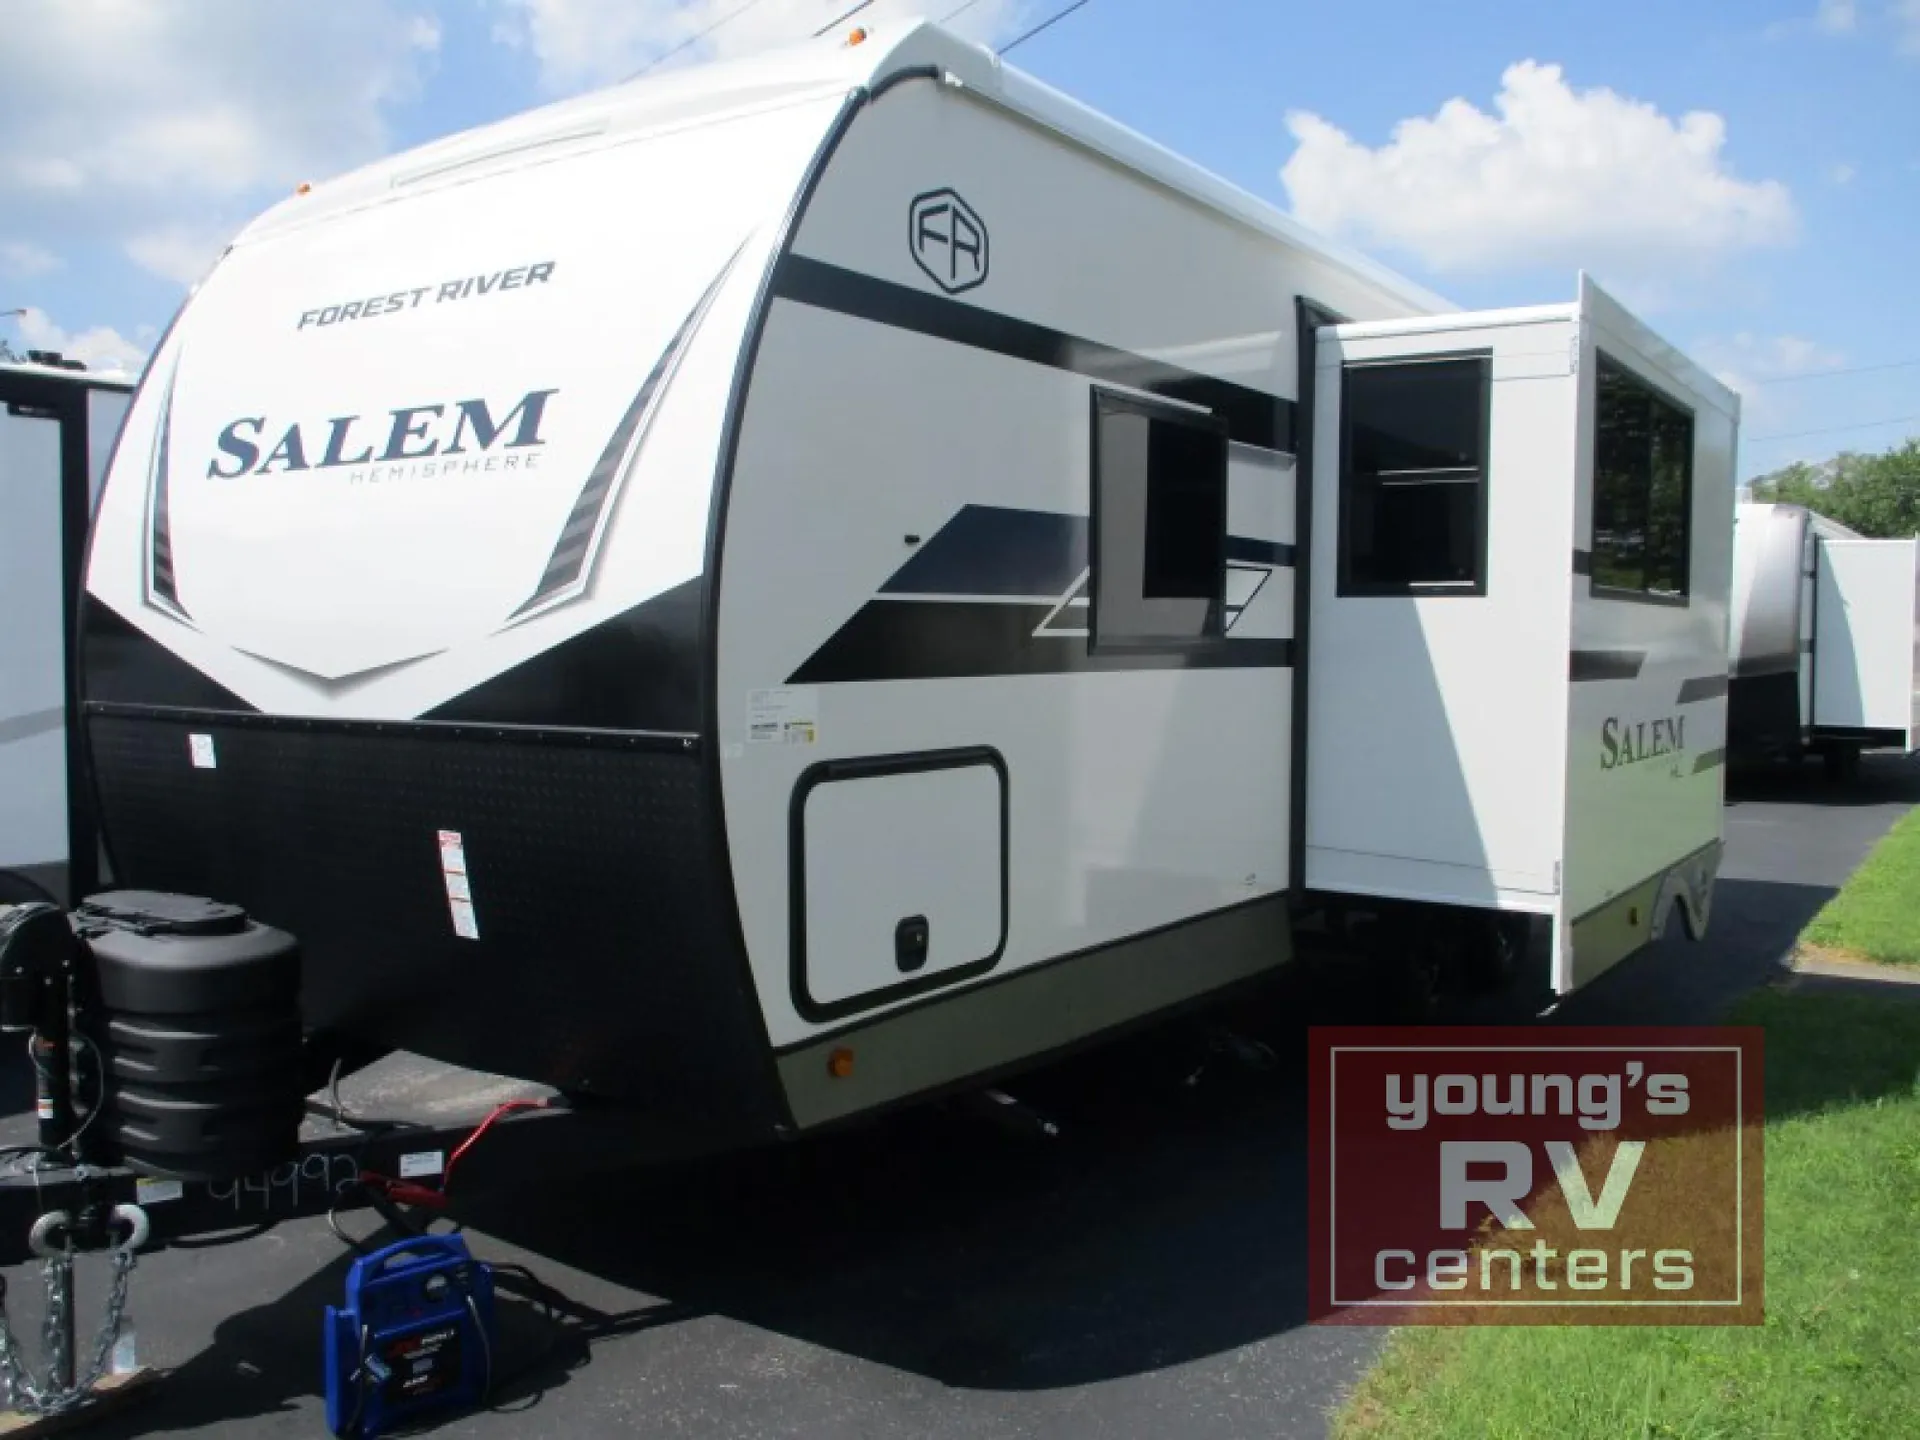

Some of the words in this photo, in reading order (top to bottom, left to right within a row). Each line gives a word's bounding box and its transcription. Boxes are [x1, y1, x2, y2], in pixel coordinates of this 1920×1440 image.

[297, 287, 433, 331] FOREST
[435, 260, 557, 303] RIVER
[206, 388, 560, 481] SALEM
[350, 453, 542, 486] HEMISPHERE
[1599, 715, 1686, 771] SALEM
